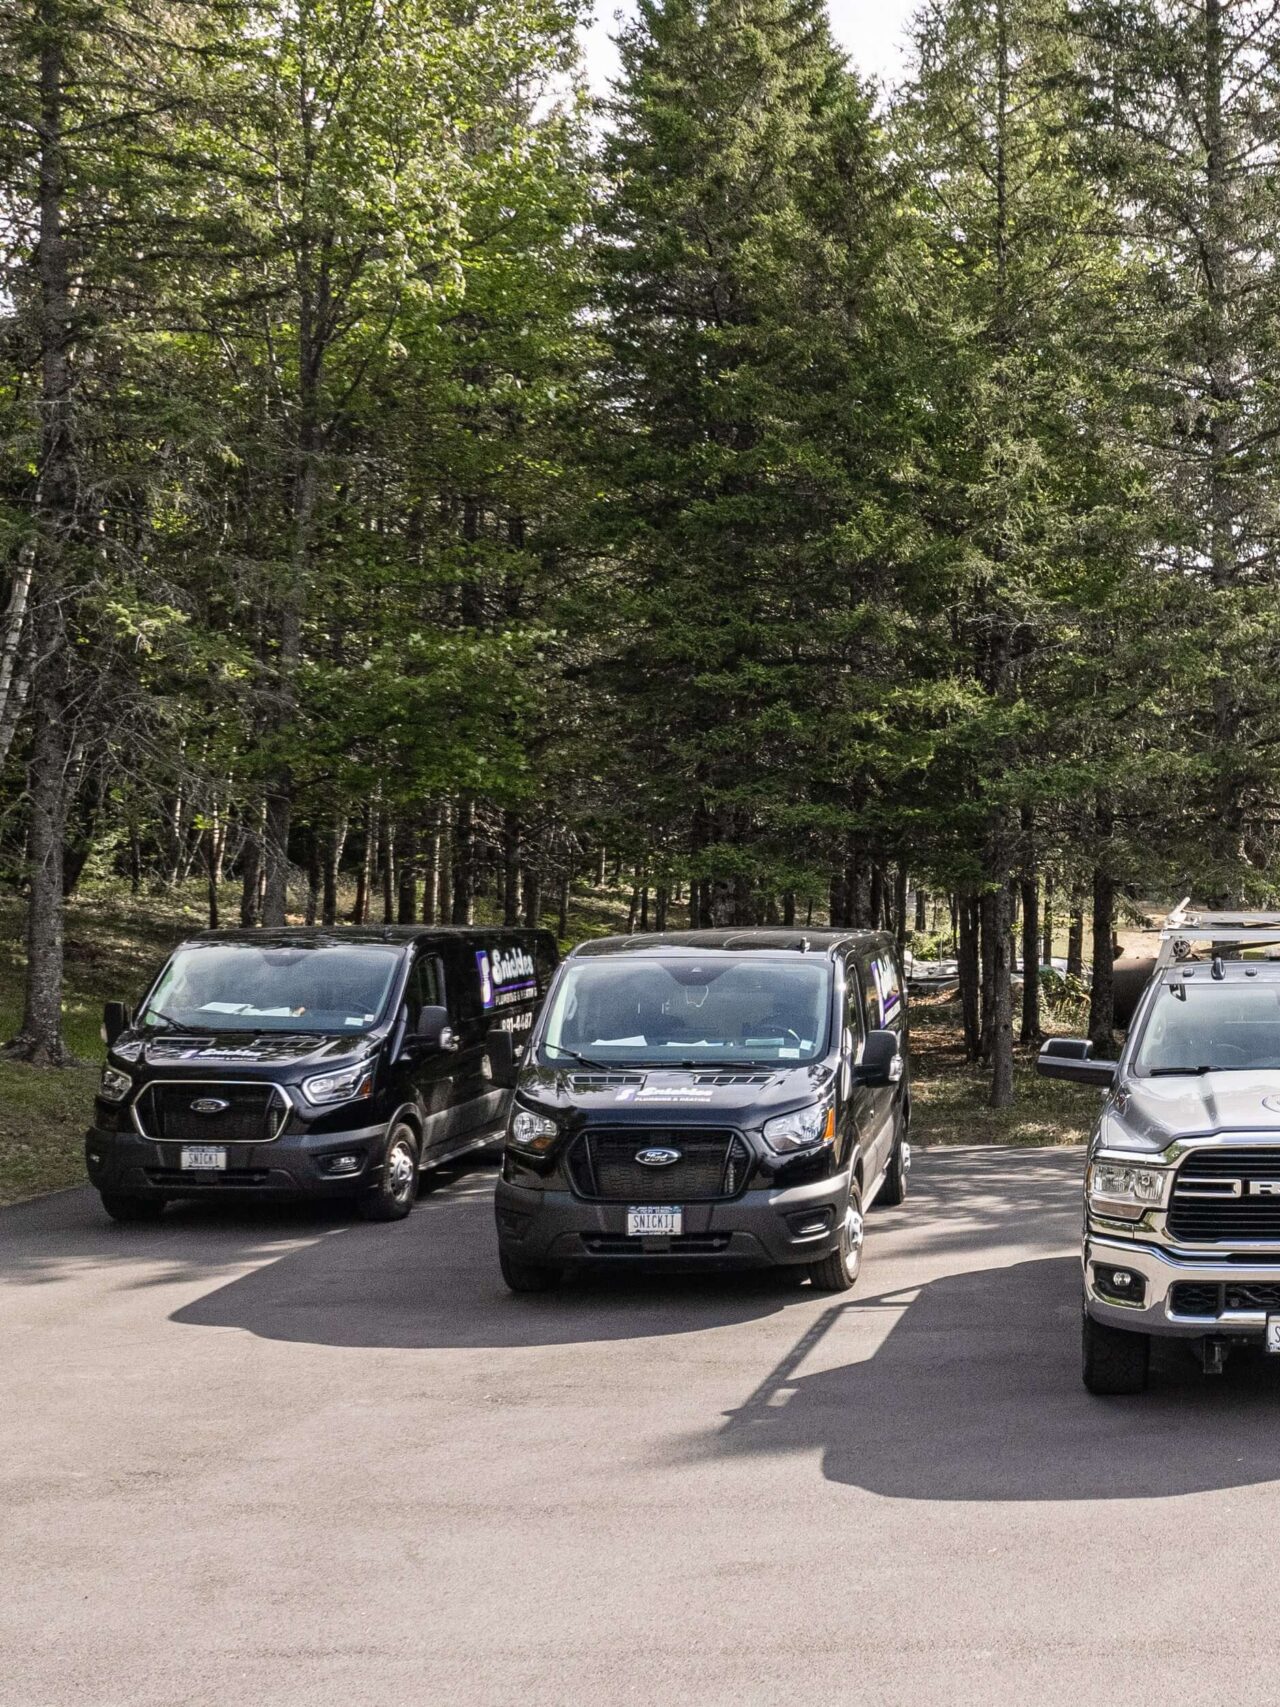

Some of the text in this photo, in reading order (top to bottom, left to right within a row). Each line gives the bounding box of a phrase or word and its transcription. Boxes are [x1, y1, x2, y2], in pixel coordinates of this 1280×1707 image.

[492, 947, 534, 985] Snickles
[502, 1011, 533, 1033] 891-4487
[633, 1214, 675, 1228] SNICKII
